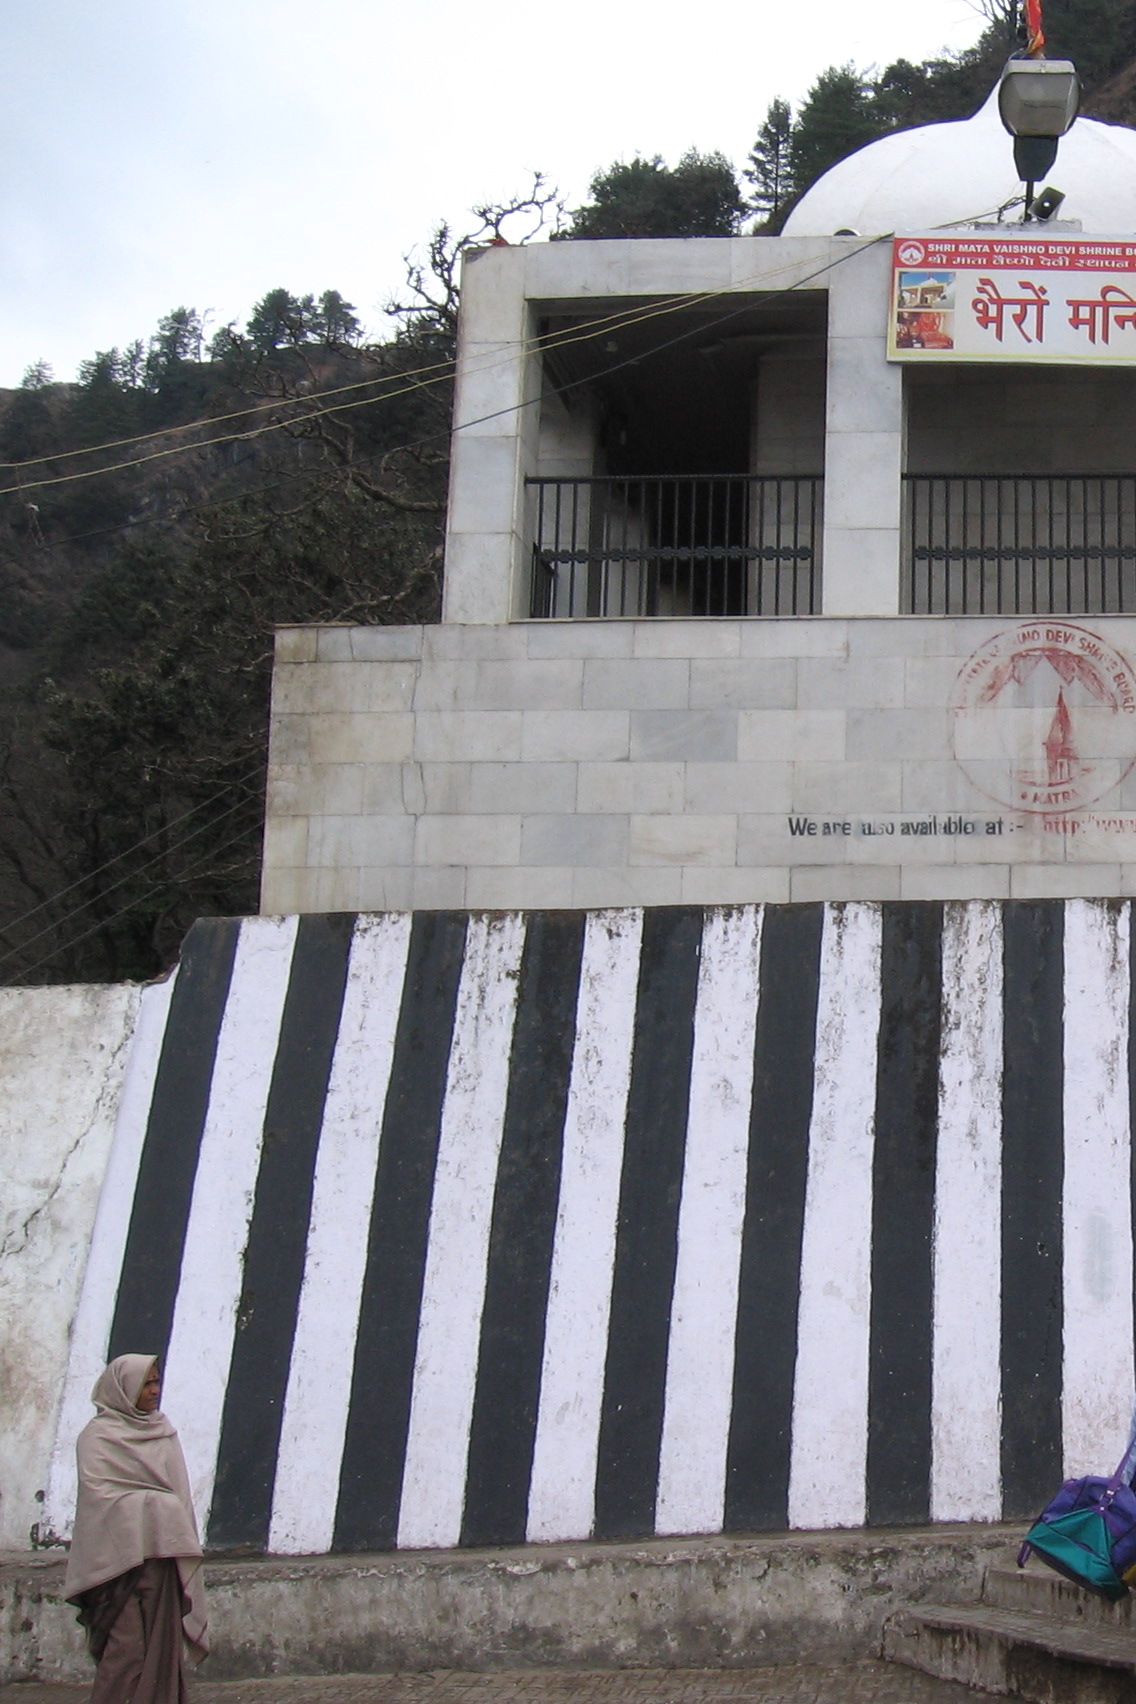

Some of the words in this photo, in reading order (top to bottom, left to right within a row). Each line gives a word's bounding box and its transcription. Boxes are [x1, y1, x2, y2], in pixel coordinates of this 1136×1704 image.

[928, 243, 955, 252] SHRI
[959, 244, 990, 253] MATA
[993, 244, 1045, 254] VAISHNO
[1049, 245, 1075, 255] DEVI
[1079, 246, 1122, 256] SHRINE
[928, 253, 948, 265] श्री
[952, 256, 987, 266] माता
[971, 278, 1050, 343] भैरों
[788, 817, 817, 836] We
[822, 820, 851, 836] are
[861, 819, 895, 836] aso
[985, 818, 1003, 836] at
